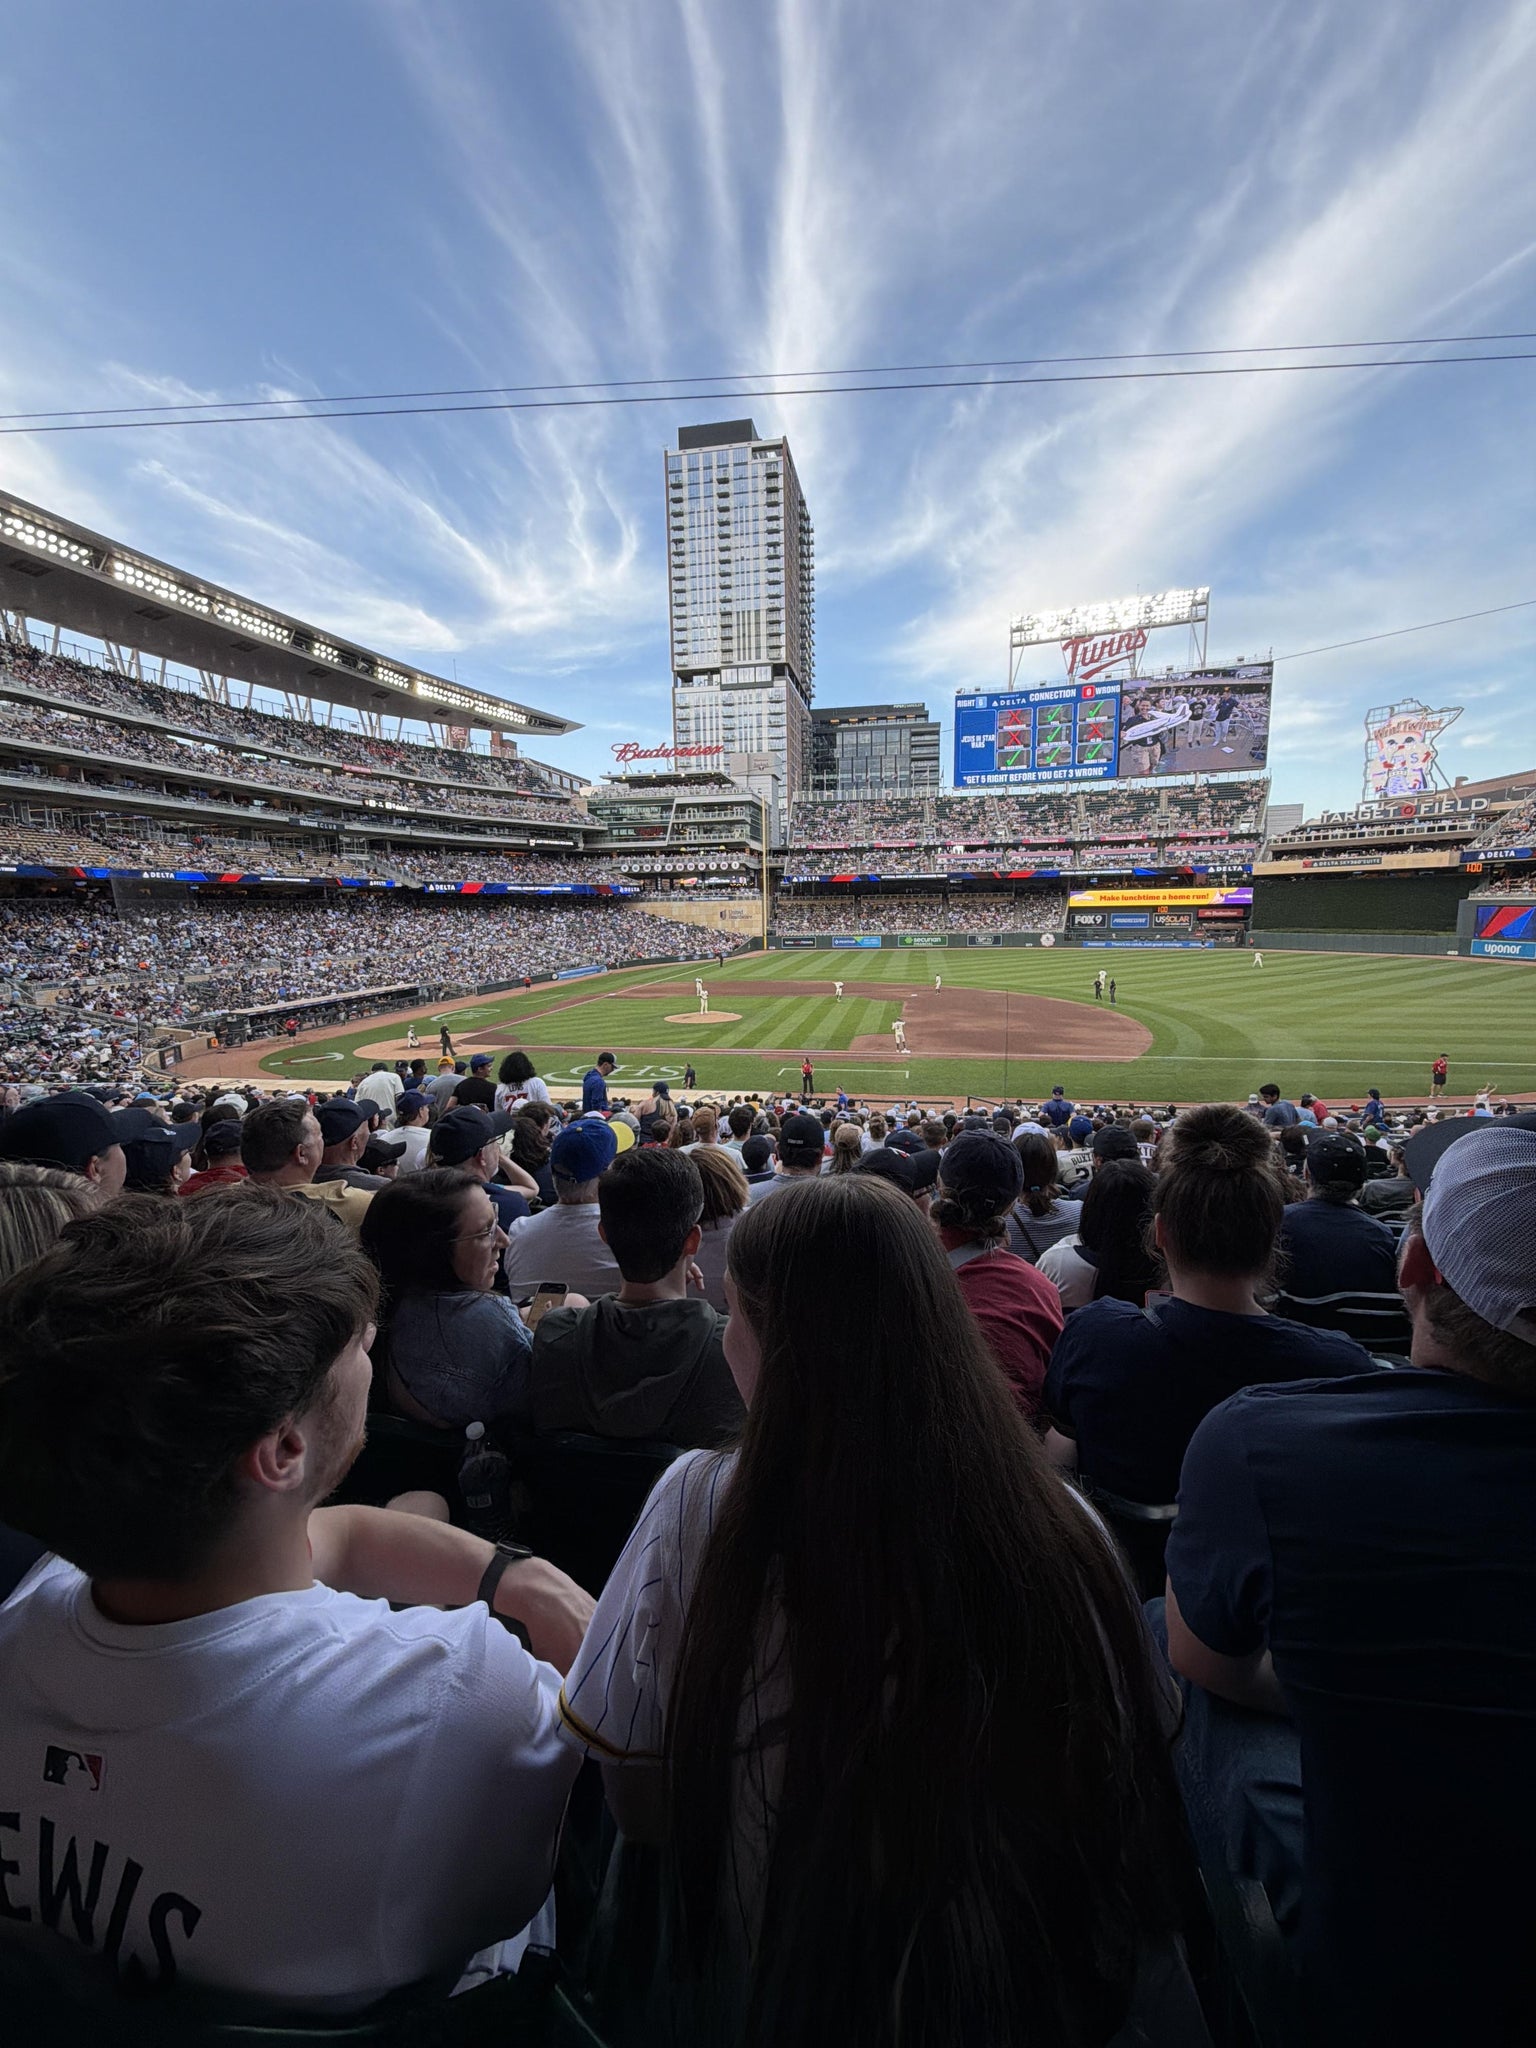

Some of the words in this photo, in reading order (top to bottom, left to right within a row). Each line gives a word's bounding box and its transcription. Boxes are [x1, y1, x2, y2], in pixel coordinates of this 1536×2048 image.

[1062, 627, 1147, 676] Twins
[1029, 688, 1076, 702] CONNECTION
[1095, 685, 1120, 696] WRONG
[956, 700, 976, 708] RIGHT
[611, 740, 725, 763] Budweiser
[986, 774, 1008, 782] RIGHT
[1009, 771, 1036, 782] BEFORE
[1037, 771, 1052, 780] YOU
[1053, 770, 1068, 778] GET
[1068, 769, 1074, 778] 3
[1320, 807, 1398, 824] TARGET
[1420, 799, 1488, 815] FIELD
[1074, 915, 1094, 924] FOX
[1095, 915, 1102, 924] 9
[1484, 944, 1521, 954] uponor
[570, 1064, 686, 1076] CHS
